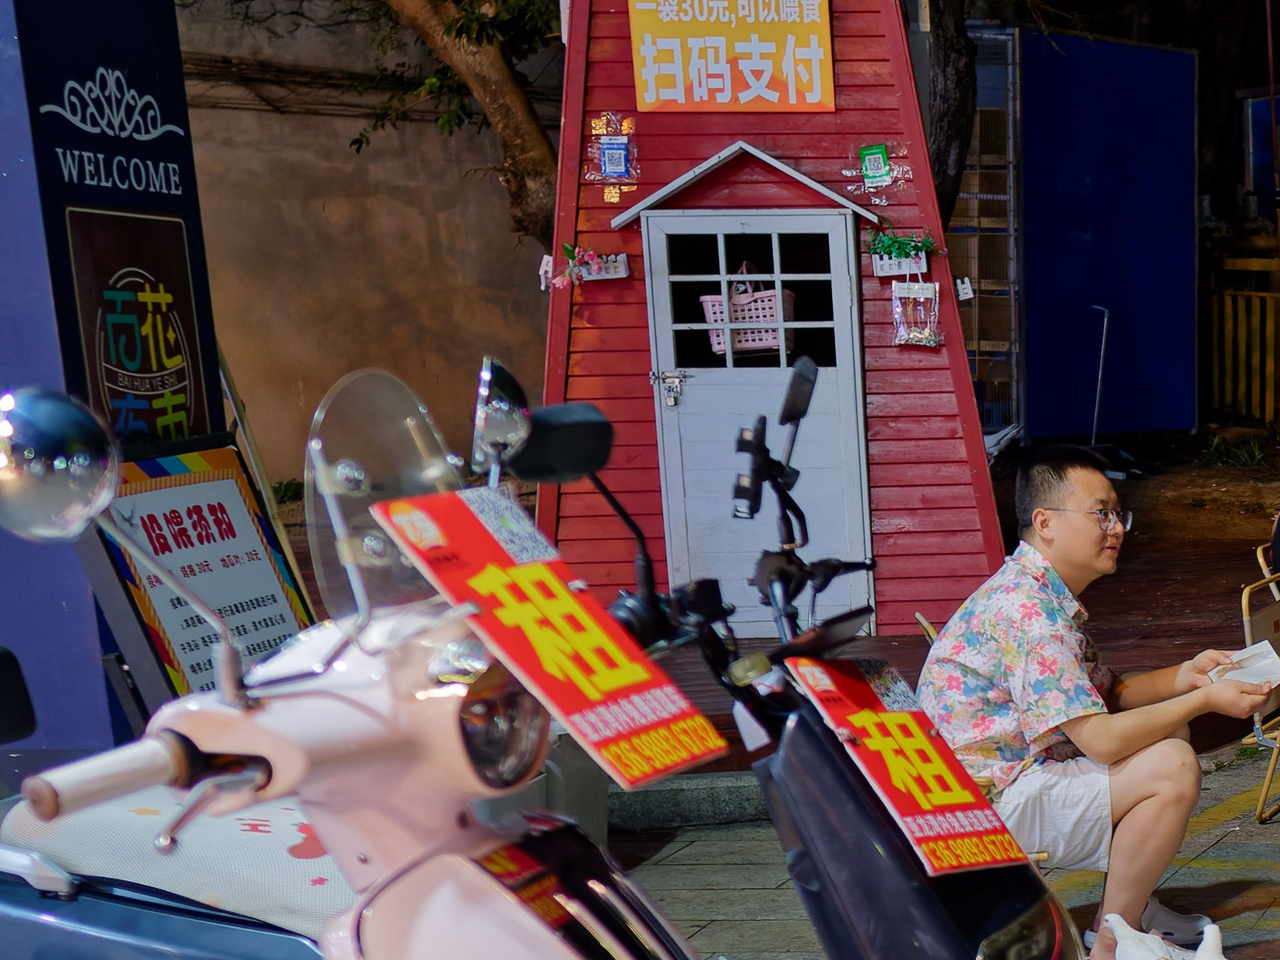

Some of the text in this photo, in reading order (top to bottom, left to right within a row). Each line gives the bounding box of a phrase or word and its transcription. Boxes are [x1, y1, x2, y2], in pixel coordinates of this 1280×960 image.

[640, 33, 825, 104] 扫码支付
[55, 147, 182, 195] WELCOME
[140, 501, 237, 557] 投喂须知
[466, 563, 651, 701] 租
[846, 708, 976, 811] 租
